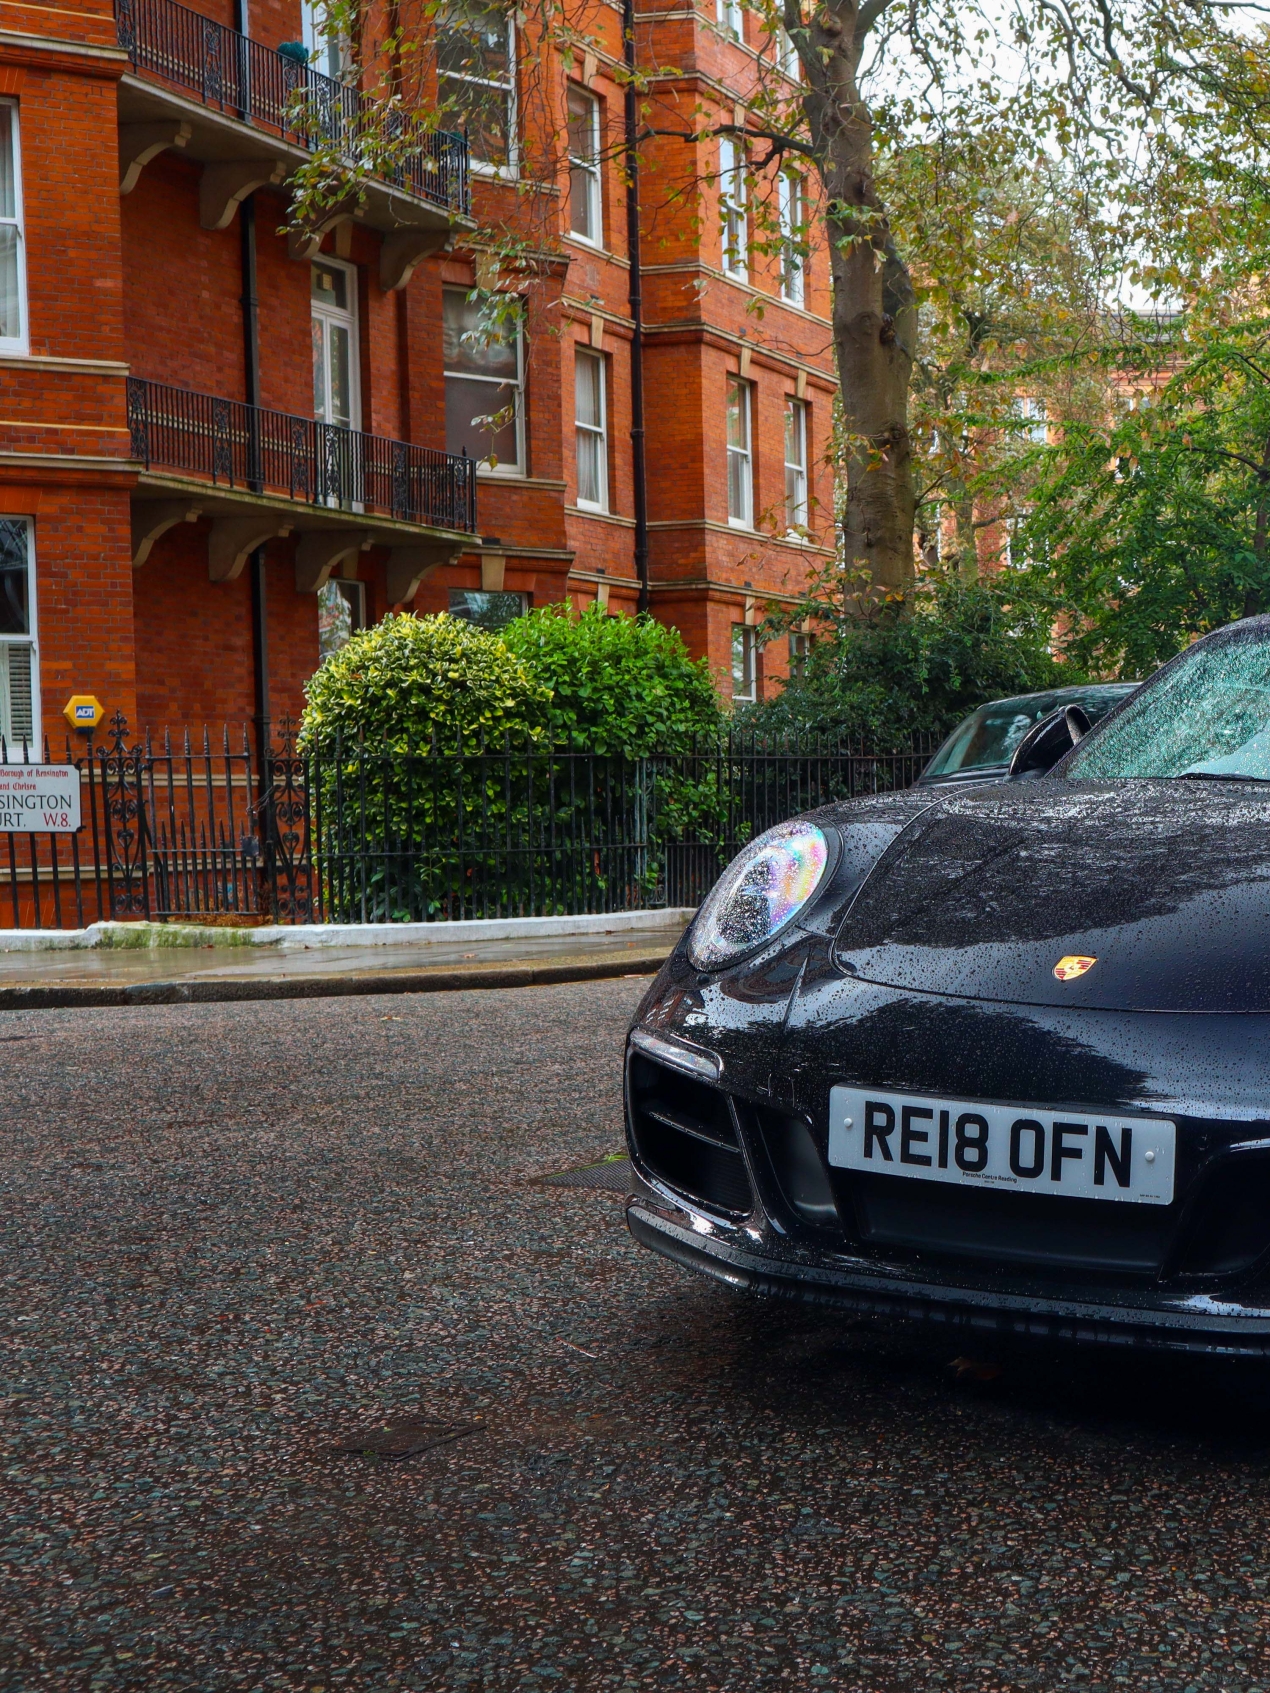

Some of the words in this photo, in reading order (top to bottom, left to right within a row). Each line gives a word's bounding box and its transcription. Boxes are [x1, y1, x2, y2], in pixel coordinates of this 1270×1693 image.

[76, 708, 95, 717] ADT
[0, 769, 24, 780] Borough
[27, 769, 33, 777] of
[36, 768, 69, 778] Kensington
[13, 782, 37, 791] Chelsea
[43, 812, 71, 828] W.8.
[863, 1100, 990, 1173] RE18
[1008, 1118, 1133, 1188] OFN
